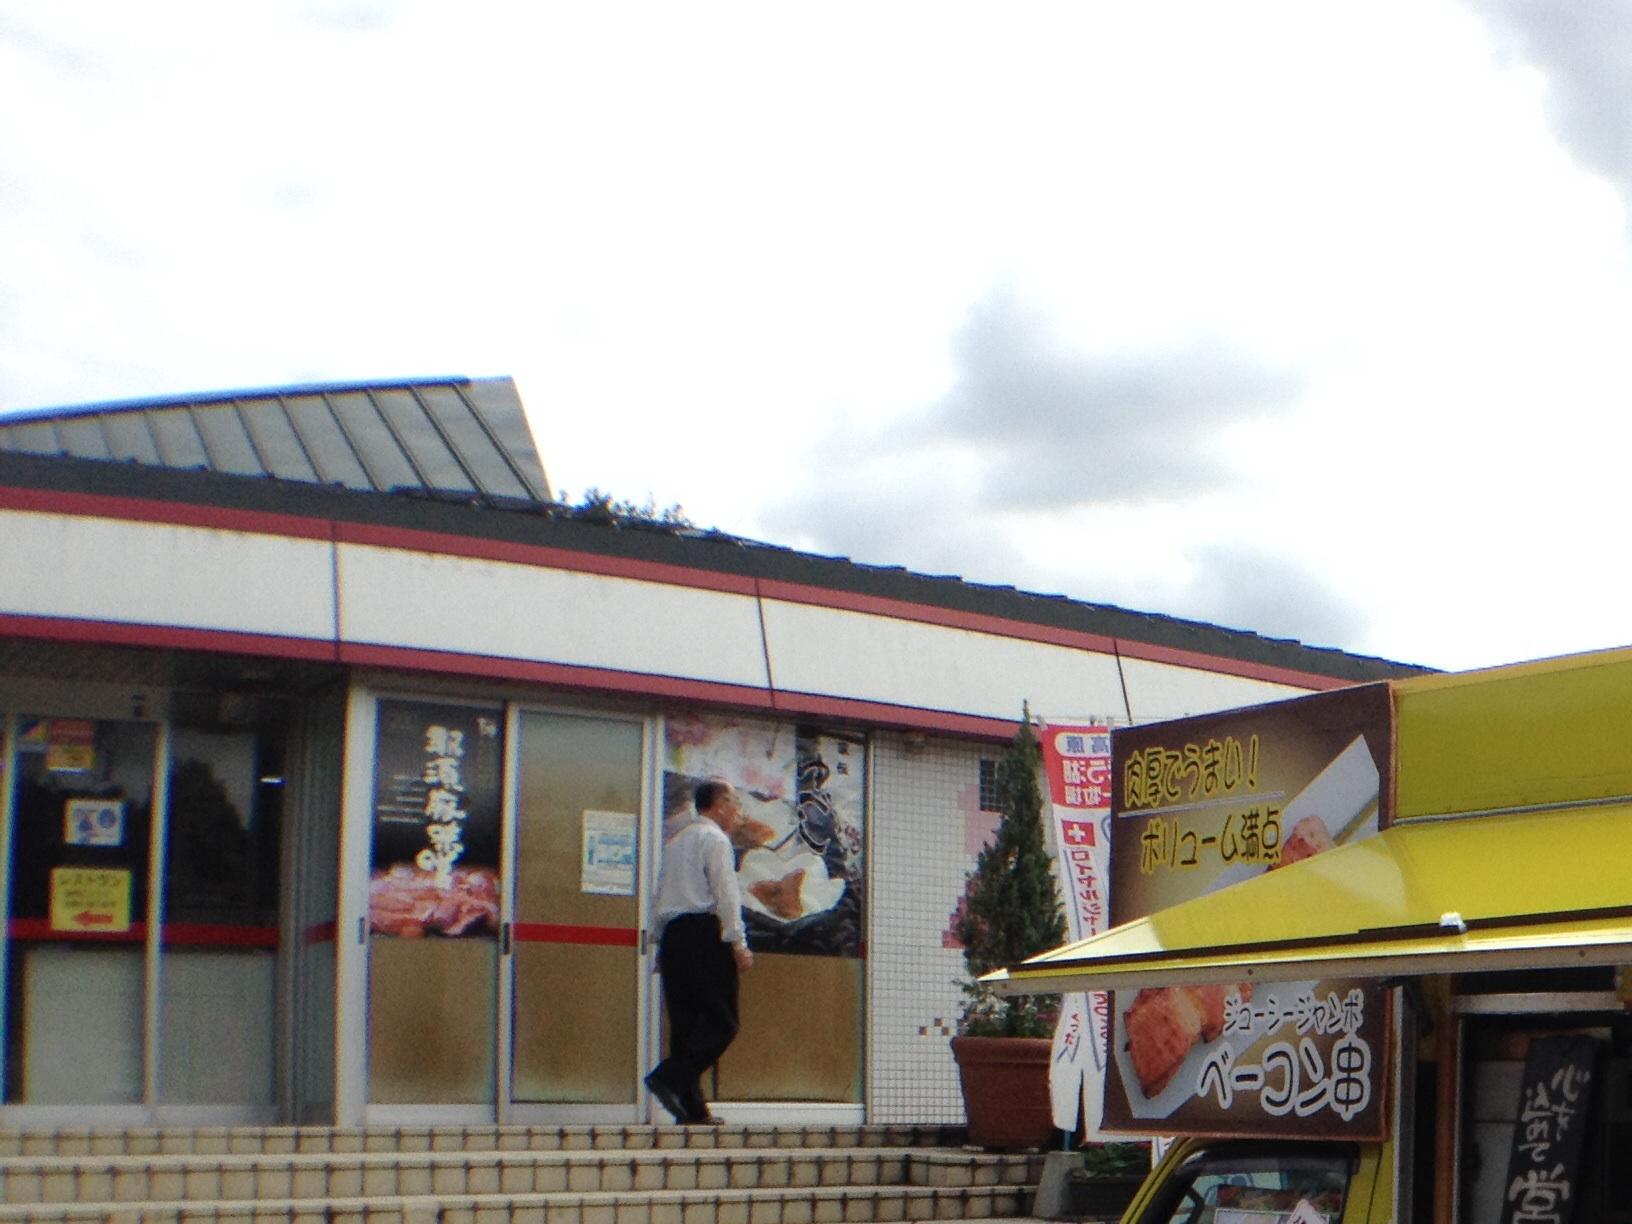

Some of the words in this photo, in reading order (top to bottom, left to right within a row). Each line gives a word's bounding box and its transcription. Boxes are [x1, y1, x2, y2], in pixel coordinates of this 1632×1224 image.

[1142, 806, 1280, 871] ボリューム満点
[1224, 989, 1363, 1035] ジューシージャンボ
[1198, 1037, 1371, 1121] ベーコン串
